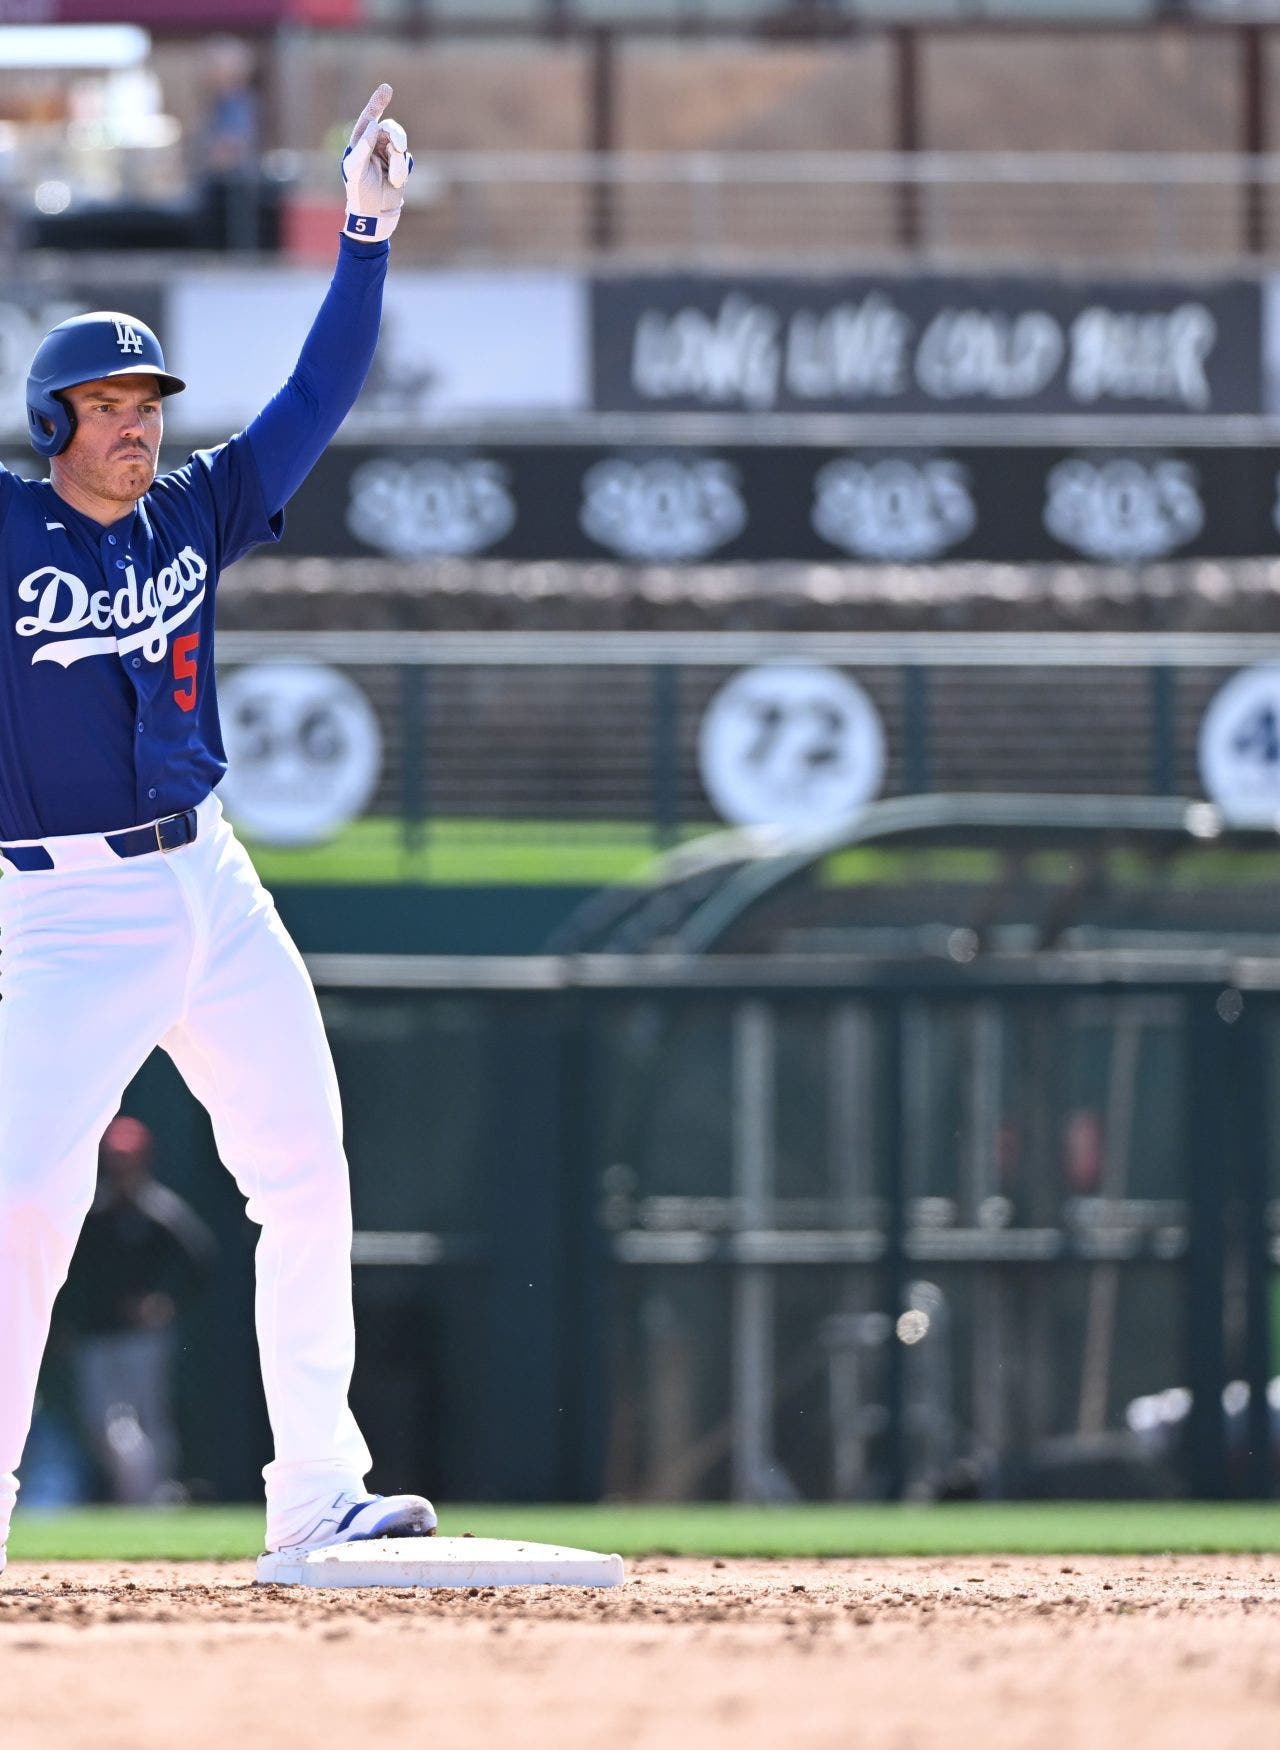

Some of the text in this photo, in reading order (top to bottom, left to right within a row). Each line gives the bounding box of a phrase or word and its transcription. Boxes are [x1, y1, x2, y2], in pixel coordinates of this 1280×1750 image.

[355, 218, 367, 232] 5
[111, 319, 143, 354] LA
[631, 292, 780, 408] LONG
[15, 545, 207, 663] Dodgers
[172, 631, 200, 713] 5
[740, 696, 852, 770] 72
[1232, 702, 1280, 768] 4
